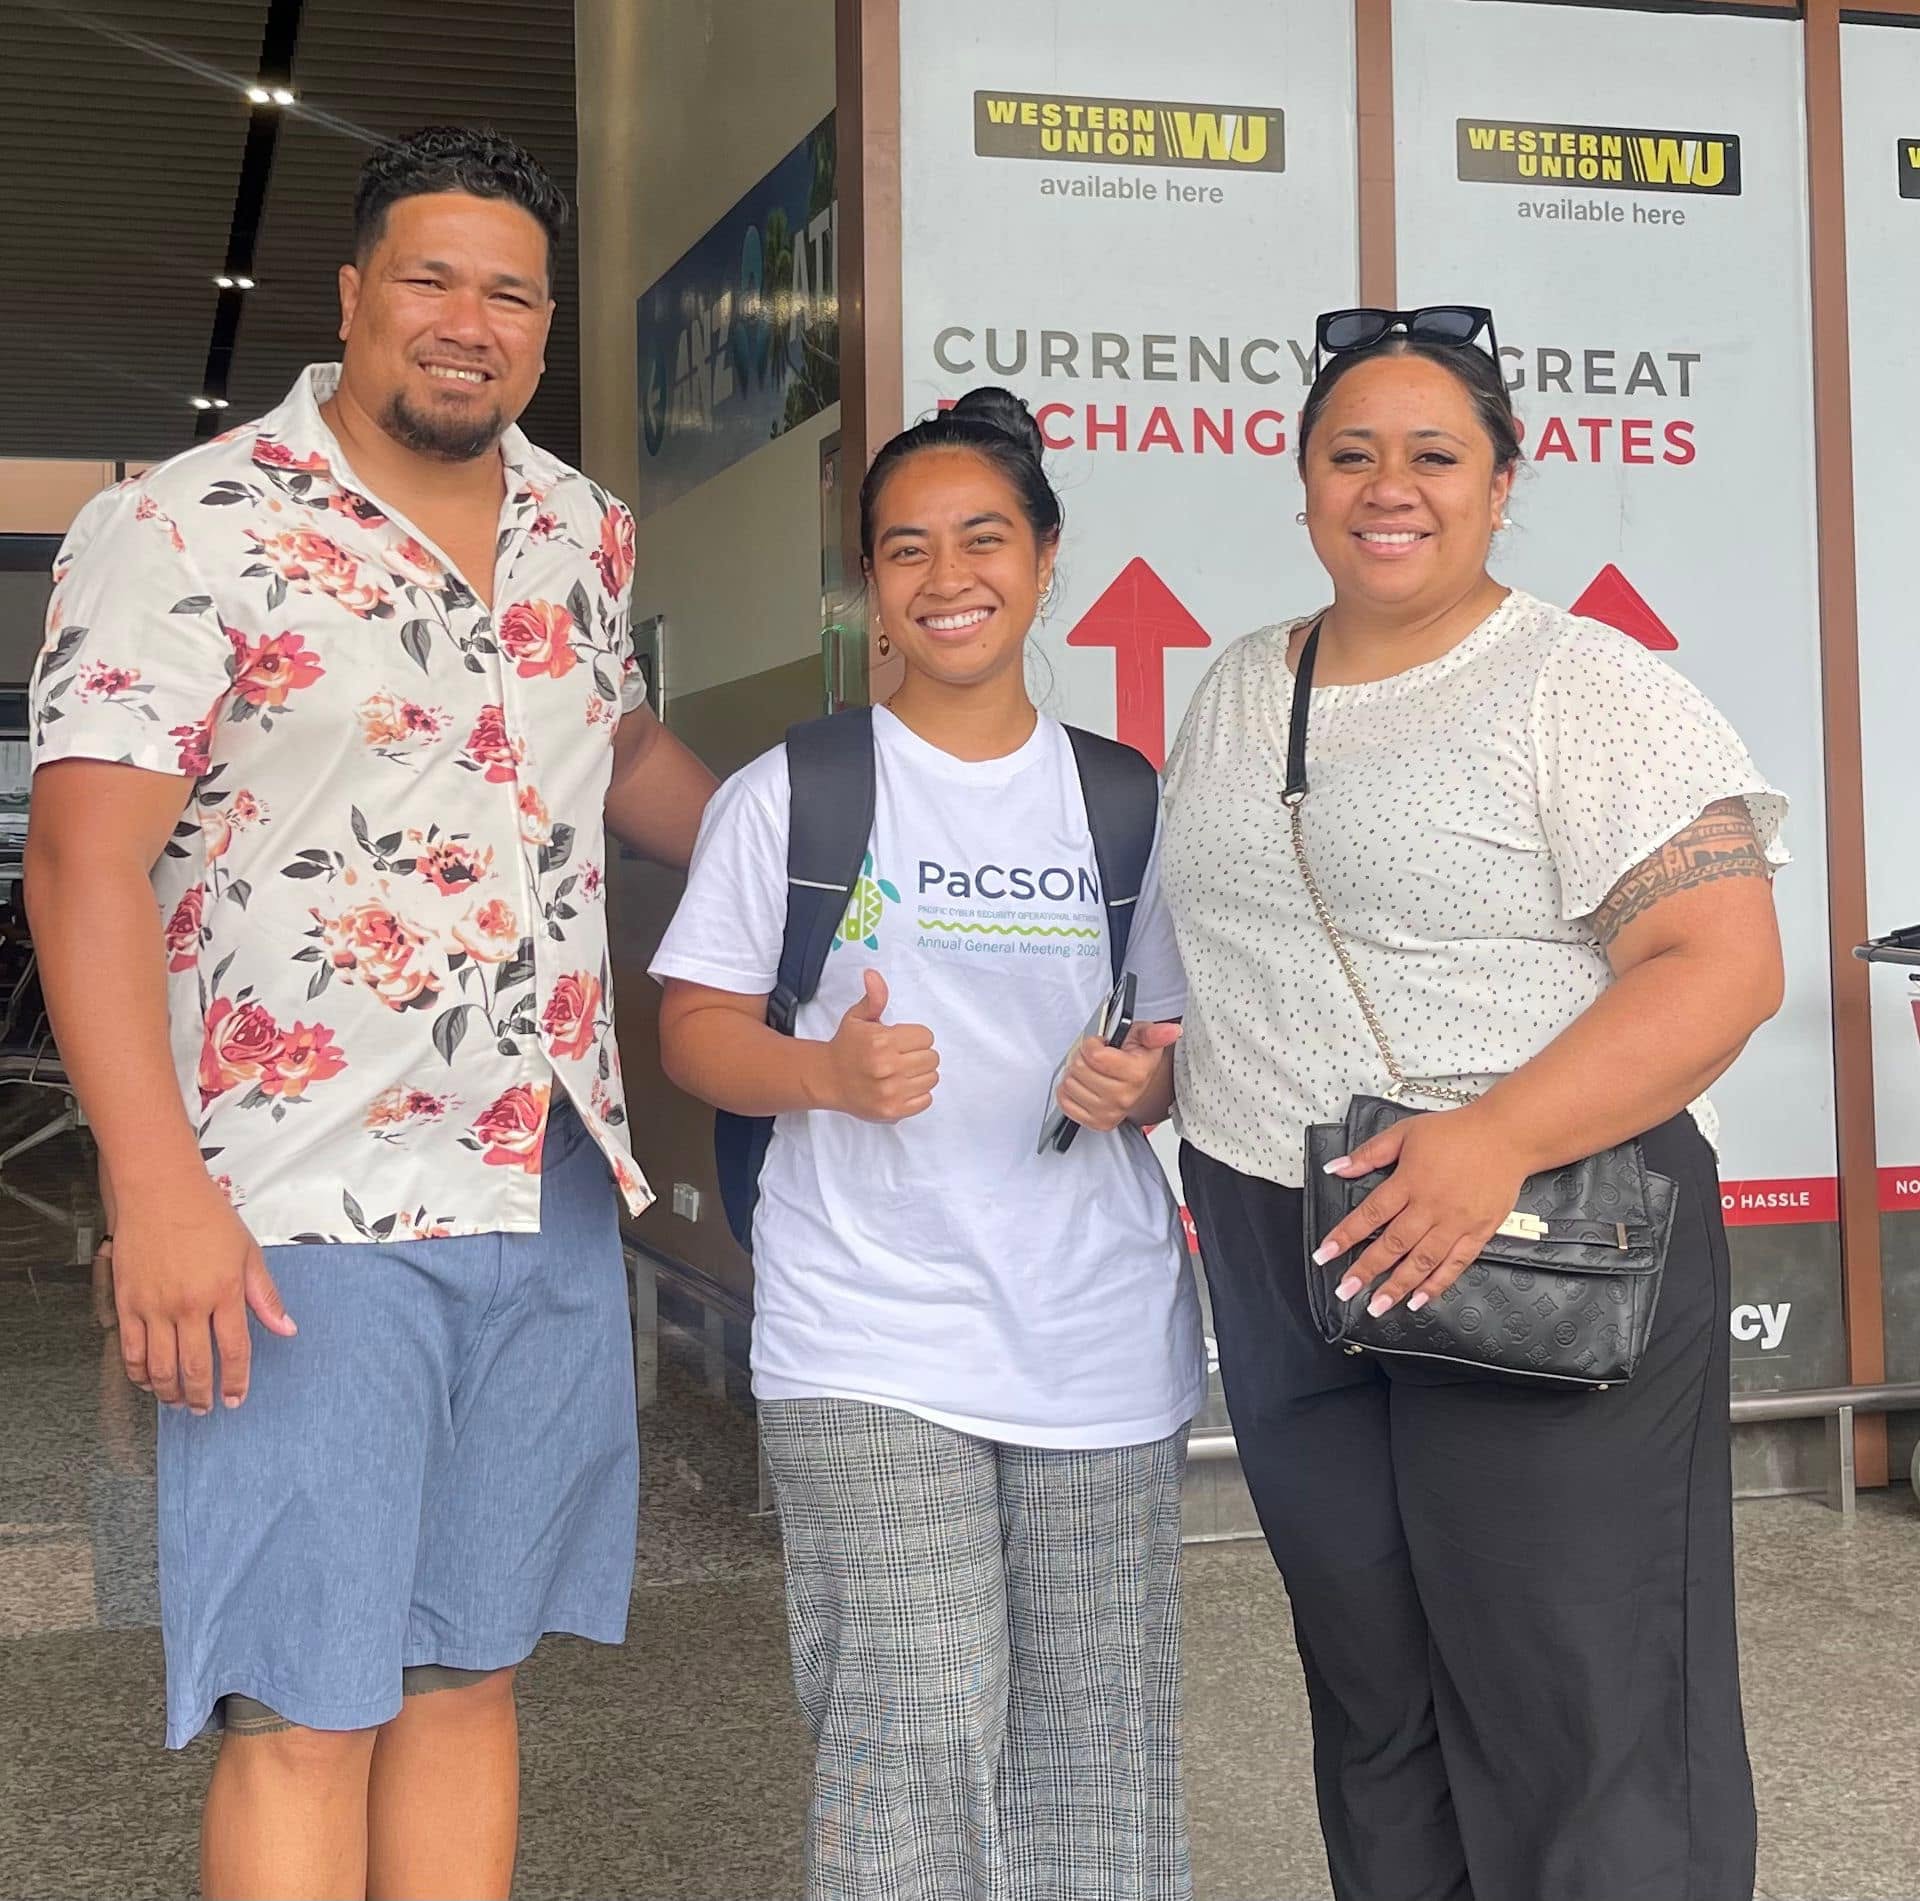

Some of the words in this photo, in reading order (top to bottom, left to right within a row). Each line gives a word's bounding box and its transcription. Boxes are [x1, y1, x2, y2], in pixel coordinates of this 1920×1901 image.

[986, 100, 1154, 132] WESTERN
[1040, 128, 1155, 157] UNION
[1172, 111, 1268, 163] WU
[1468, 127, 1622, 158] WESTERN
[1518, 154, 1622, 181] UNION
[1638, 137, 1726, 187] WU
[1040, 174, 1158, 200] available
[1166, 179, 1224, 204] here
[1517, 198, 1625, 222] available
[1632, 202, 1686, 226] here
[933, 326, 1316, 387] CURRENCY
[1498, 346, 1701, 398] GREAT
[937, 399, 1304, 456] CHANG
[918, 860, 1099, 905] PaCSON
[917, 905, 947, 915] PACIFIC
[949, 907, 975, 918] CYBER
[977, 910, 1016, 920] SECURITY
[917, 935, 961, 950] Annual
[964, 939, 1015, 954] General
[1020, 942, 1072, 958] Meeting
[1740, 1191, 1810, 1209] HASSLE
[1896, 1179, 1920, 1195] NO
